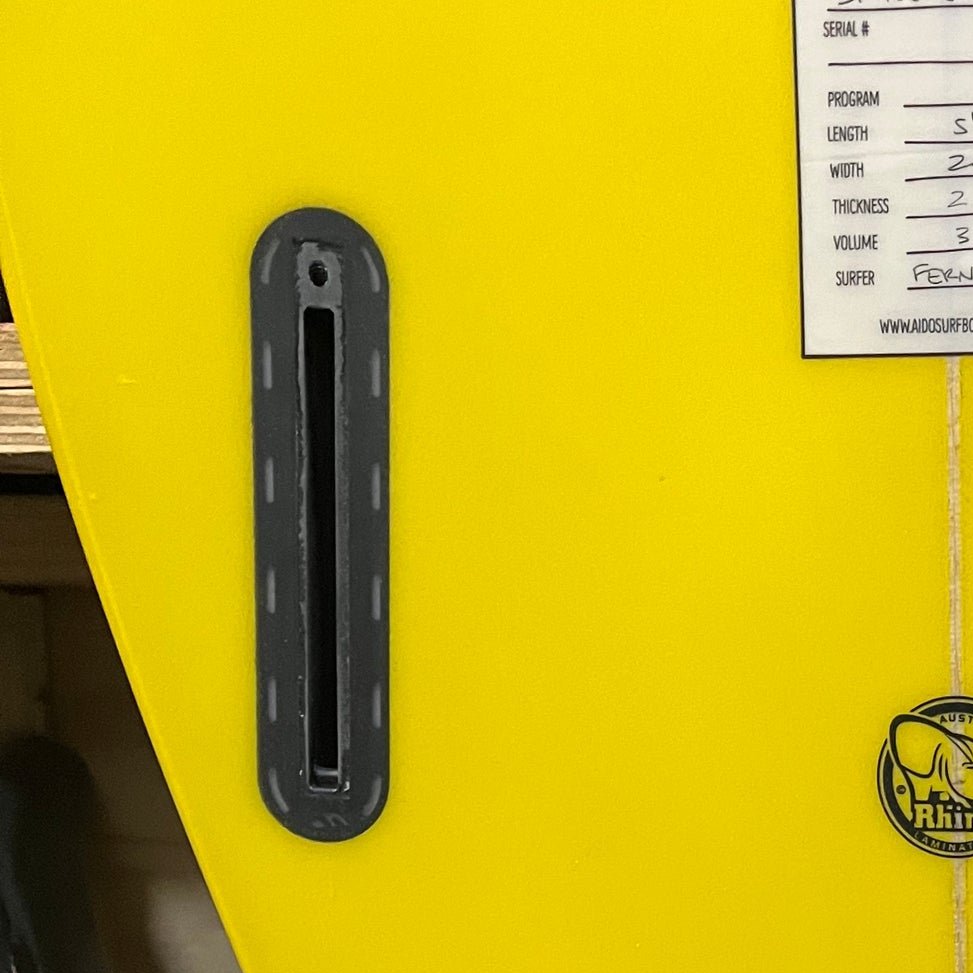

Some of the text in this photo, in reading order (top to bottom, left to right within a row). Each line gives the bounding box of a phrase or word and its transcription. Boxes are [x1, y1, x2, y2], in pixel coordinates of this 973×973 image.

[823, 21, 869, 37] SERIAL #
[828, 91, 880, 107] PROGRAM
[827, 126, 868, 142] LENGTH
[830, 163, 864, 178] WIDTH
[832, 198, 889, 214] THICKNESS
[833, 234, 878, 250] VOLUME
[835, 270, 875, 286] SURFER
